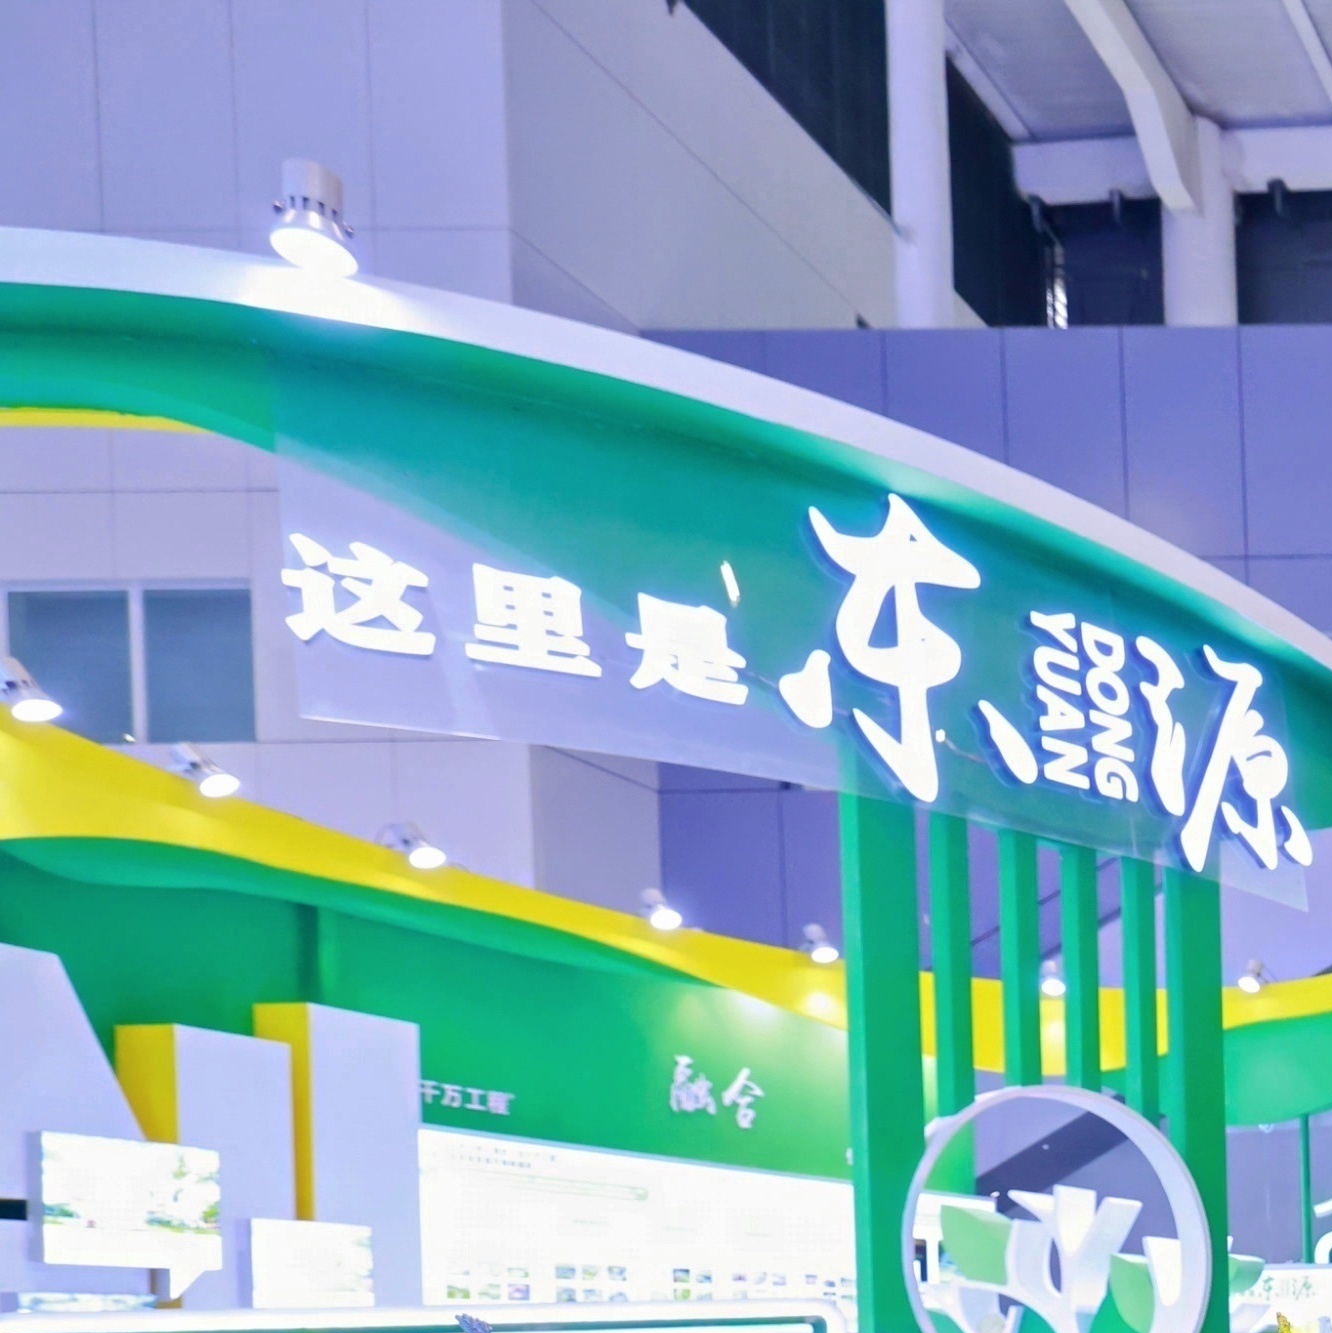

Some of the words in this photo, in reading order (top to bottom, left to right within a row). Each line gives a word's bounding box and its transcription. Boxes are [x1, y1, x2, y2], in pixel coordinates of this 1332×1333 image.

[281, 533, 749, 706] 这里是
[1030, 610, 1090, 790] YUAN
[1081, 621, 1139, 803] DONG
